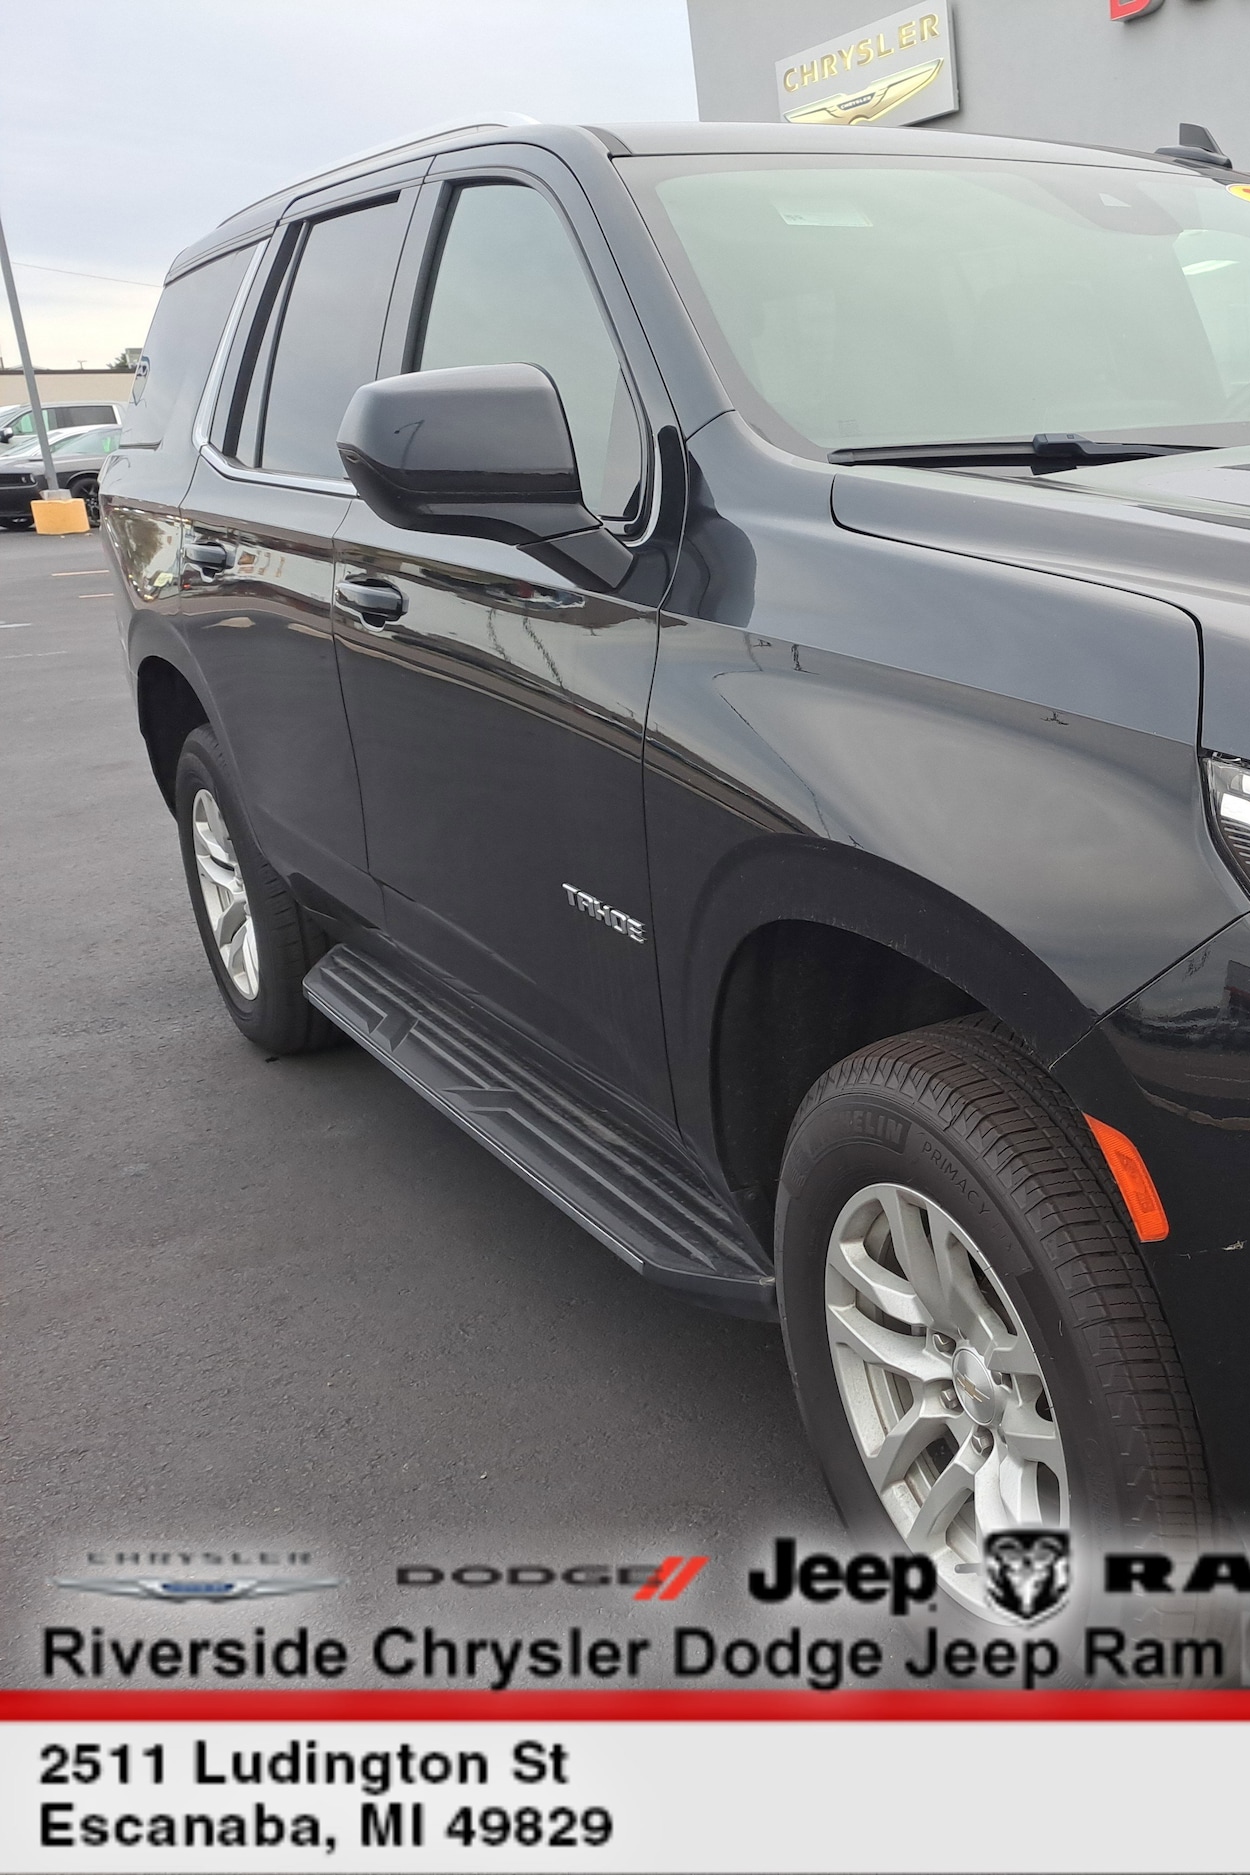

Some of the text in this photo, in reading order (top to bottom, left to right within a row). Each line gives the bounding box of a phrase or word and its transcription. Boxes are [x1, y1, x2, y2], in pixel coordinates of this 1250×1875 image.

[783, 13, 940, 93] CHRYSLER
[562, 883, 646, 944] TAHOE
[922, 1141, 991, 1215] PRIMACY
